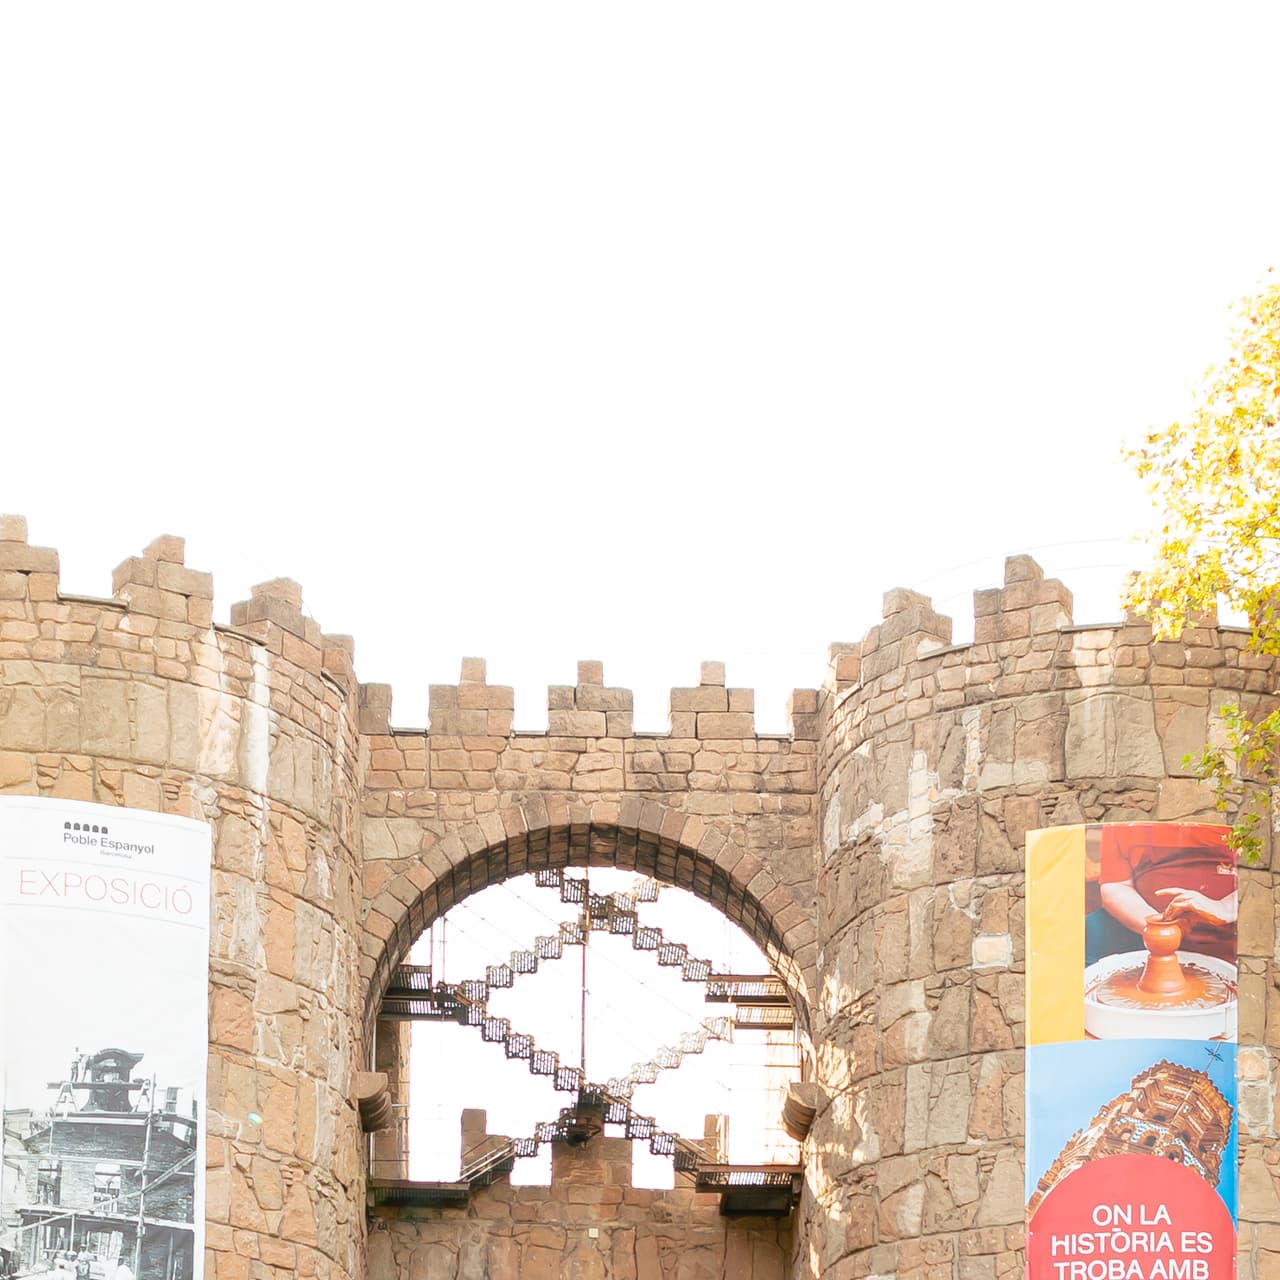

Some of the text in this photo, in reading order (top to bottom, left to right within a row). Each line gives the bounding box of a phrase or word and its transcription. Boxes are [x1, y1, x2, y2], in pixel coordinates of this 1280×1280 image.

[63, 832, 154, 855] Poble Espanyol
[19, 869, 193, 915] EXPOSICIÓ
[1092, 1204, 1172, 1226] ON LA
[1181, 1231, 1213, 1253] ES
[1149, 1259, 1209, 1280] AMB
